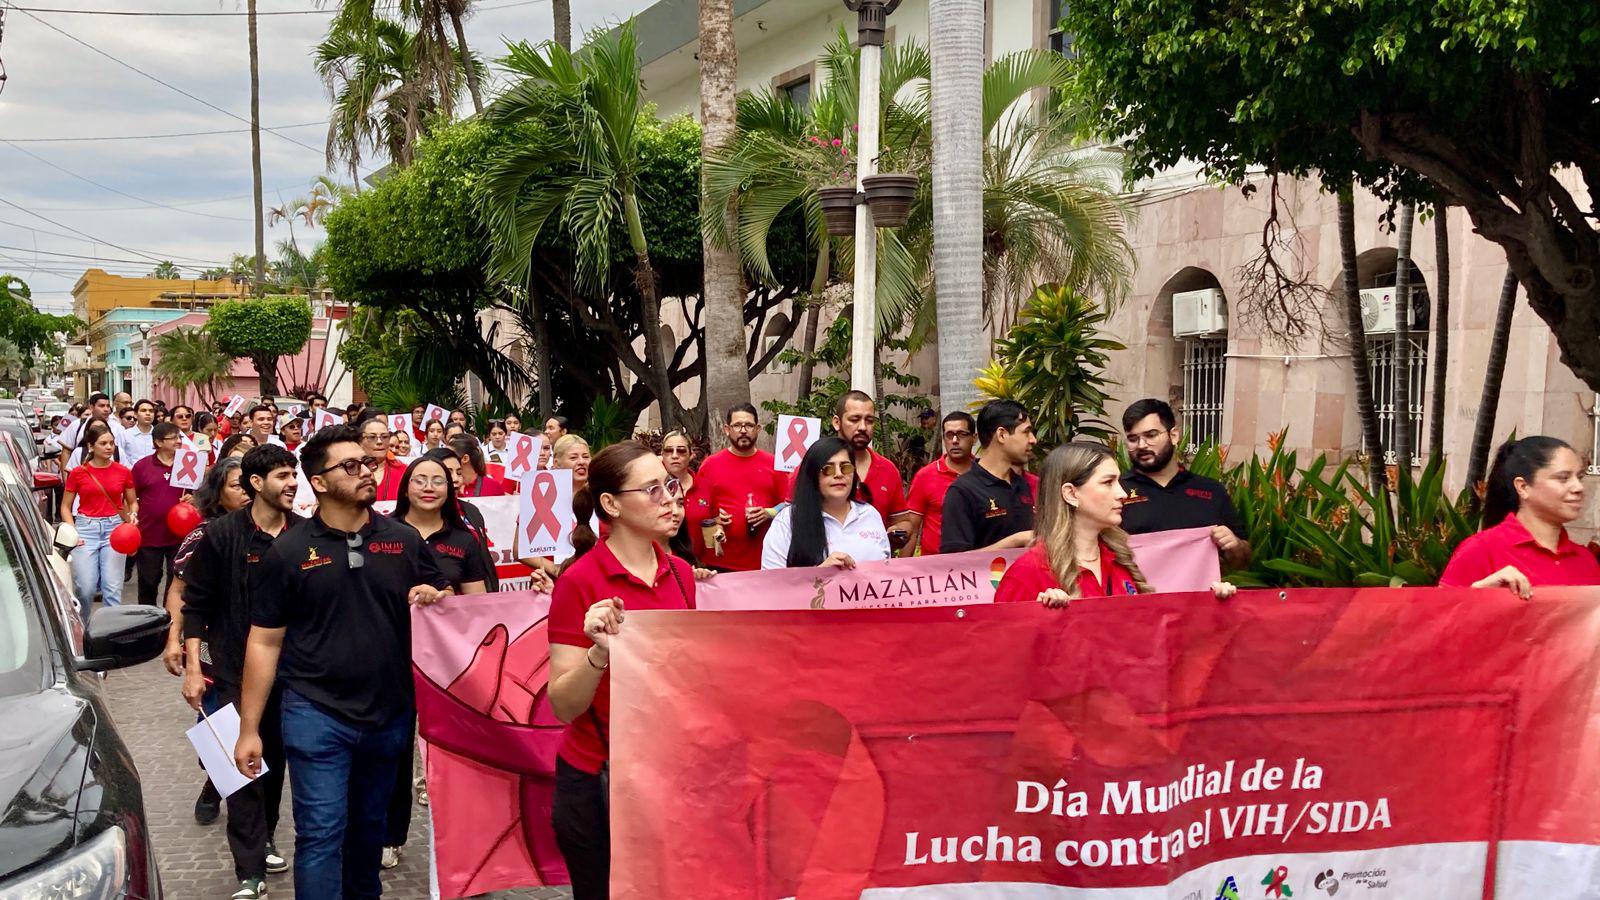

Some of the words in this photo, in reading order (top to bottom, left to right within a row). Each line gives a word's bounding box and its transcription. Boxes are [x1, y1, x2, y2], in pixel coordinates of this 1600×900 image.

[839, 569, 979, 603] MAZATLÁN
[944, 594, 979, 603] TODOS
[1014, 778, 1089, 818] Día
[1100, 760, 1235, 815] Mundial
[1240, 758, 1285, 793] de
[1290, 757, 1324, 791] la
[903, 826, 1043, 866] Lucha
[1055, 830, 1185, 868] contra
[1187, 809, 1212, 846] el
[1220, 797, 1393, 844] VIH/SIDA
[1341, 868, 1387, 880] Promoción
[1367, 880, 1389, 889] Salud
